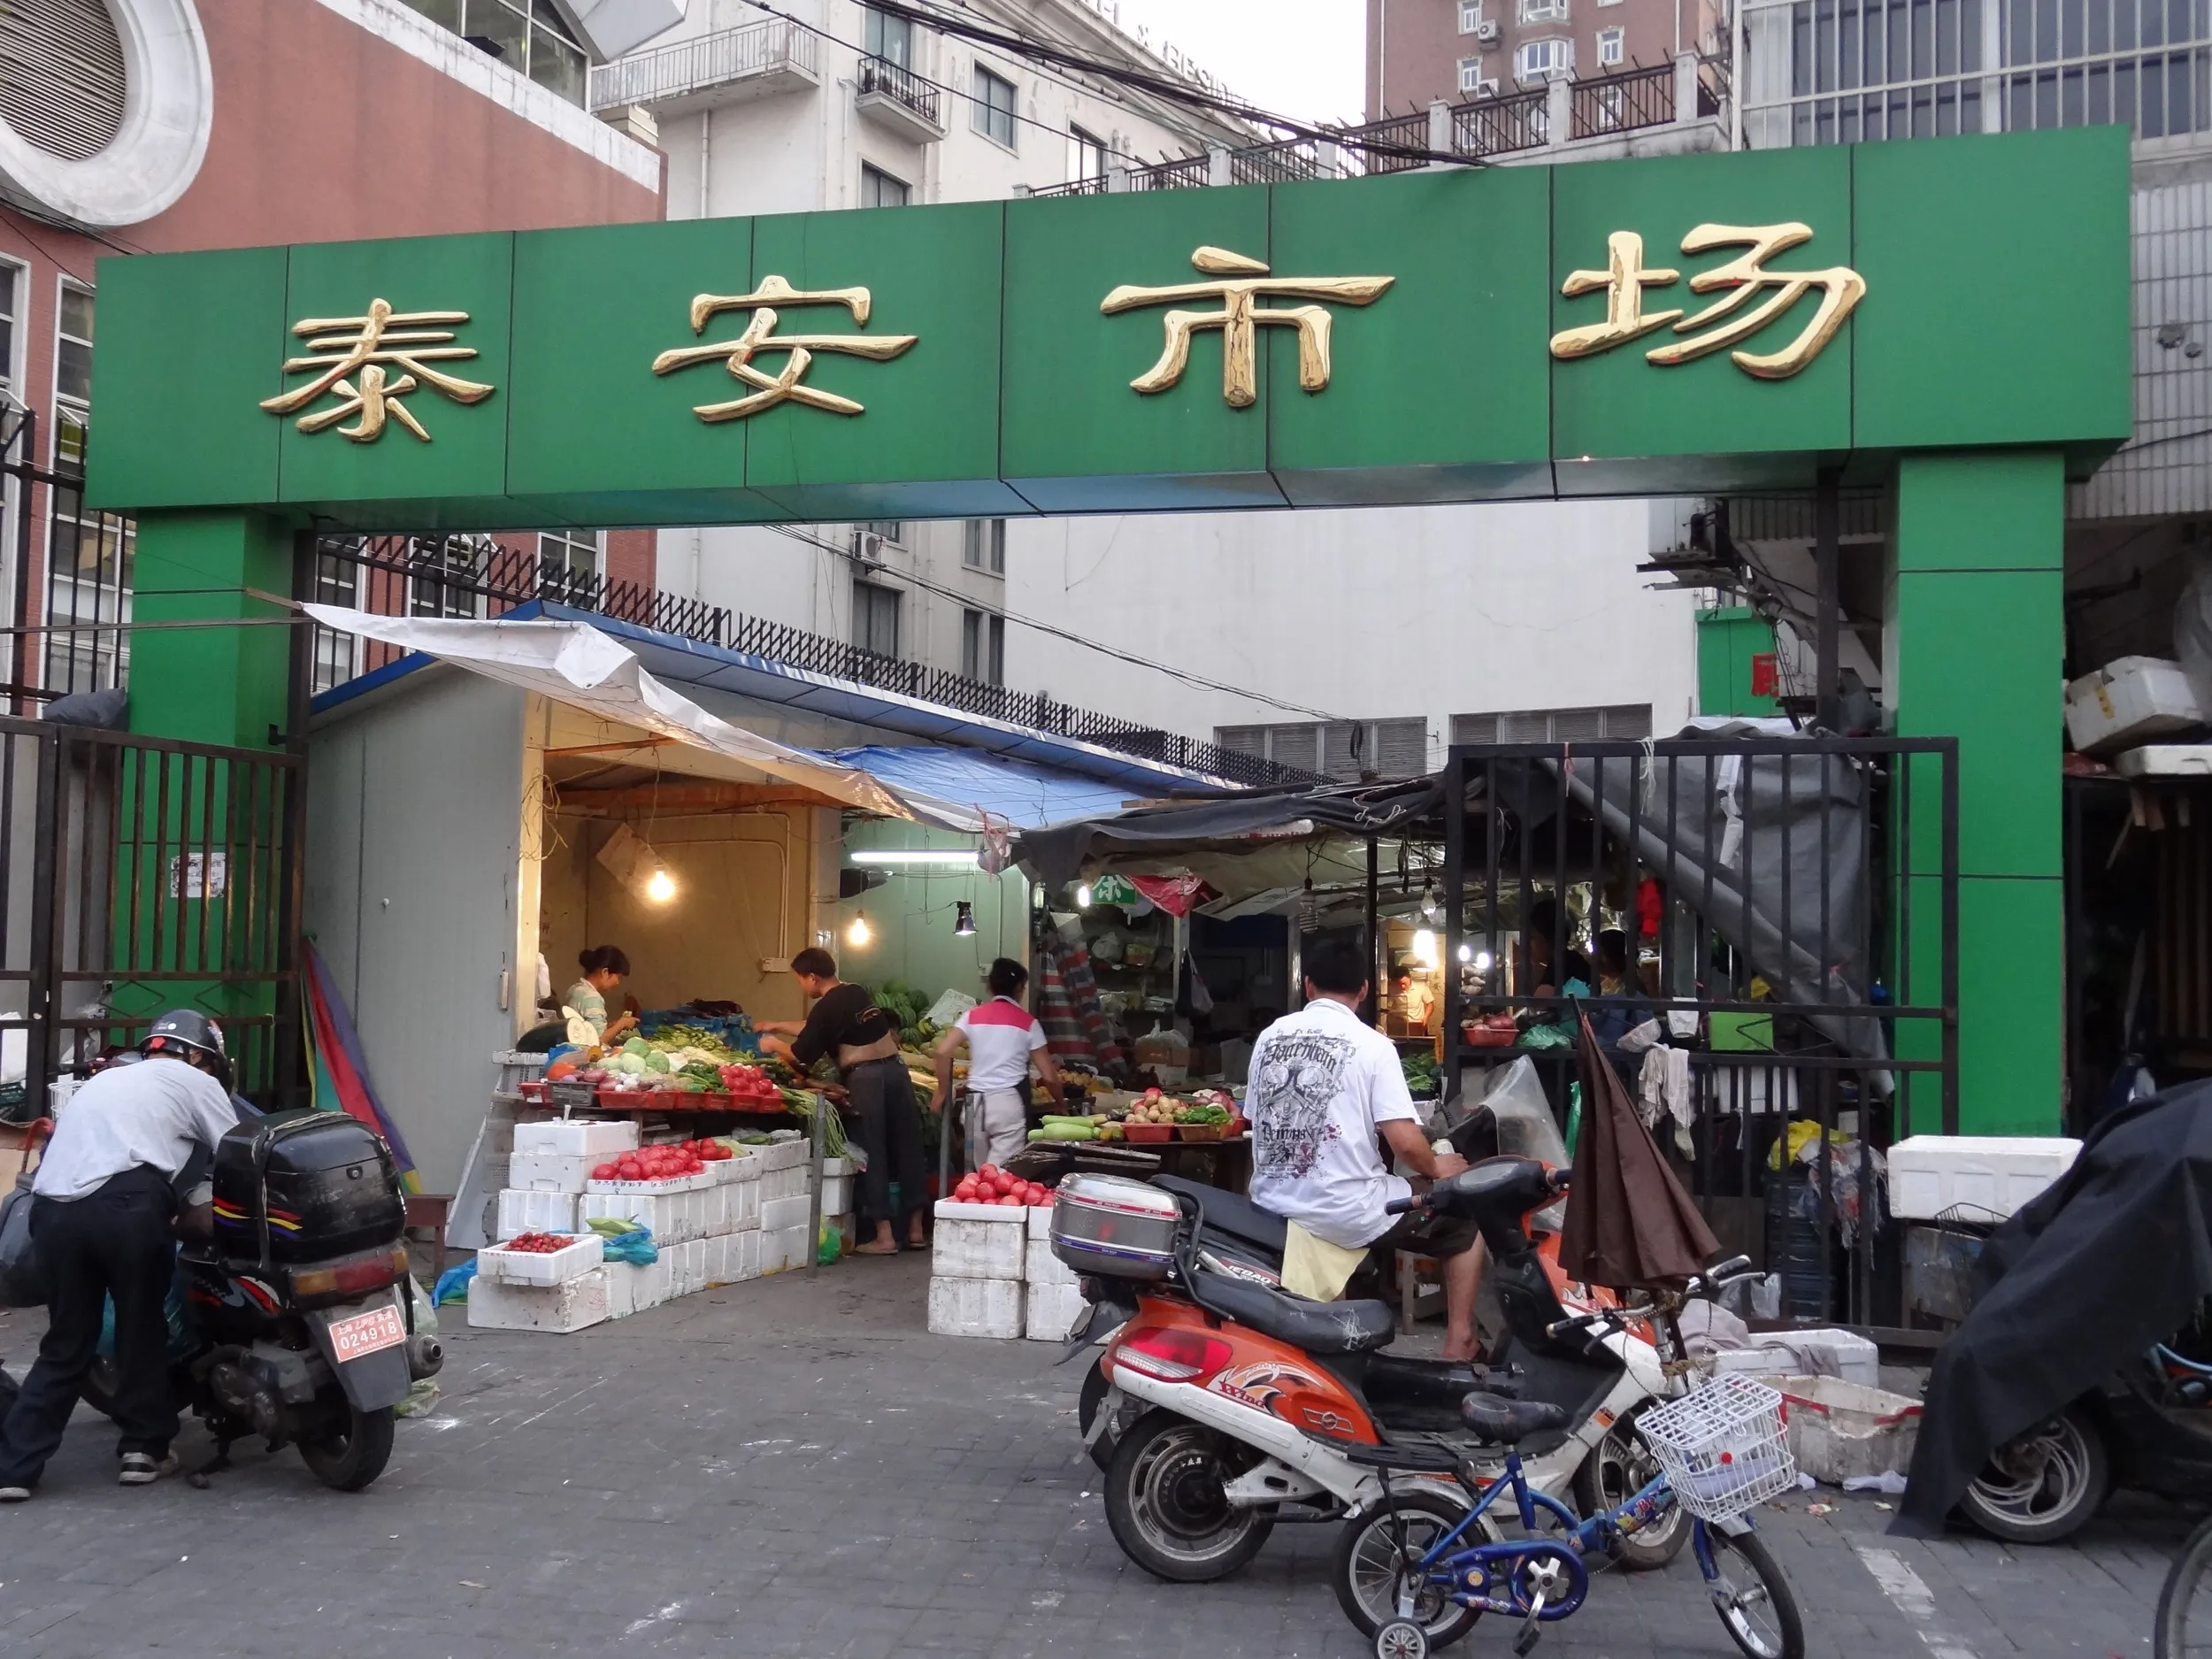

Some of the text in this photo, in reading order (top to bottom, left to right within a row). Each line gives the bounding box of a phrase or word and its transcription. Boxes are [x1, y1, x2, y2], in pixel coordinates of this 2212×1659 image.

[259, 222, 1866, 443] 泰安市场
[340, 1321, 397, 1349] 024918
